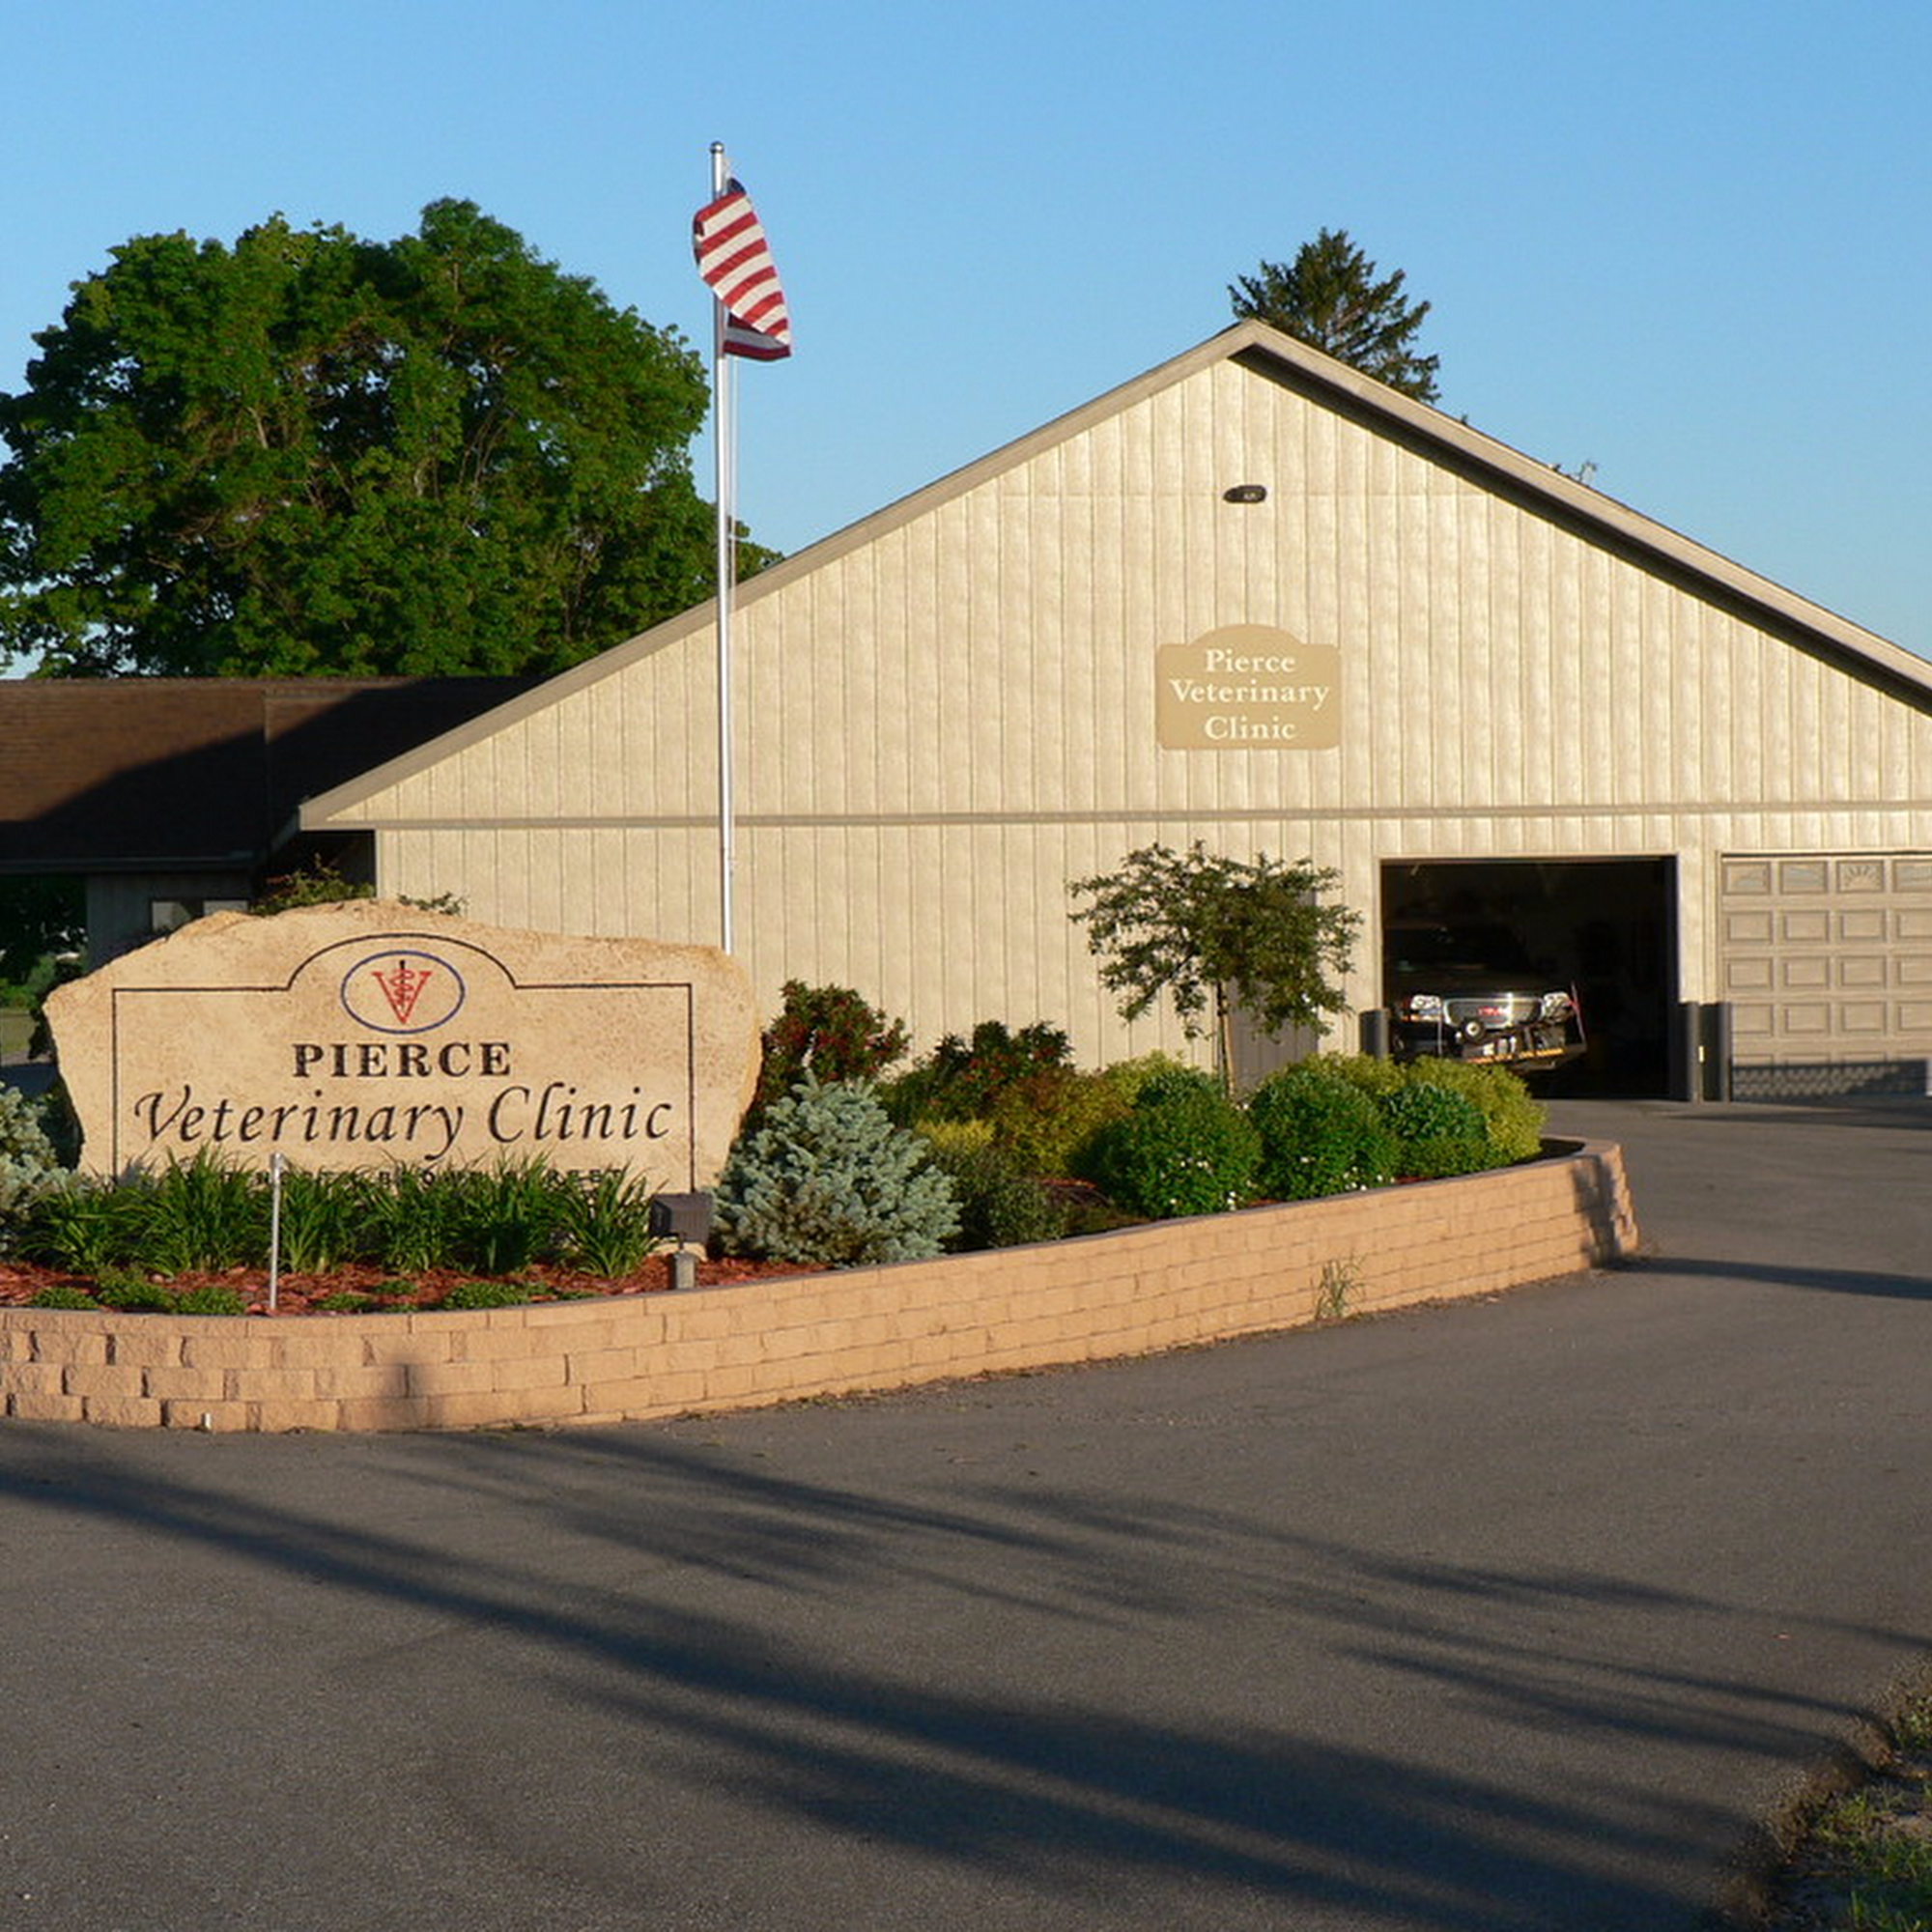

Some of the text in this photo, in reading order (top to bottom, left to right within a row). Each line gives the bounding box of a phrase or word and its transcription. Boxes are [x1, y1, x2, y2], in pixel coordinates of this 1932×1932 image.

[1206, 648, 1296, 673] Pierce
[1167, 678, 1330, 712] Veterinary
[1204, 715, 1297, 740] Clinic
[292, 1042, 511, 1078] PIERCE
[133, 1081, 672, 1162] Veterinary Clinic
